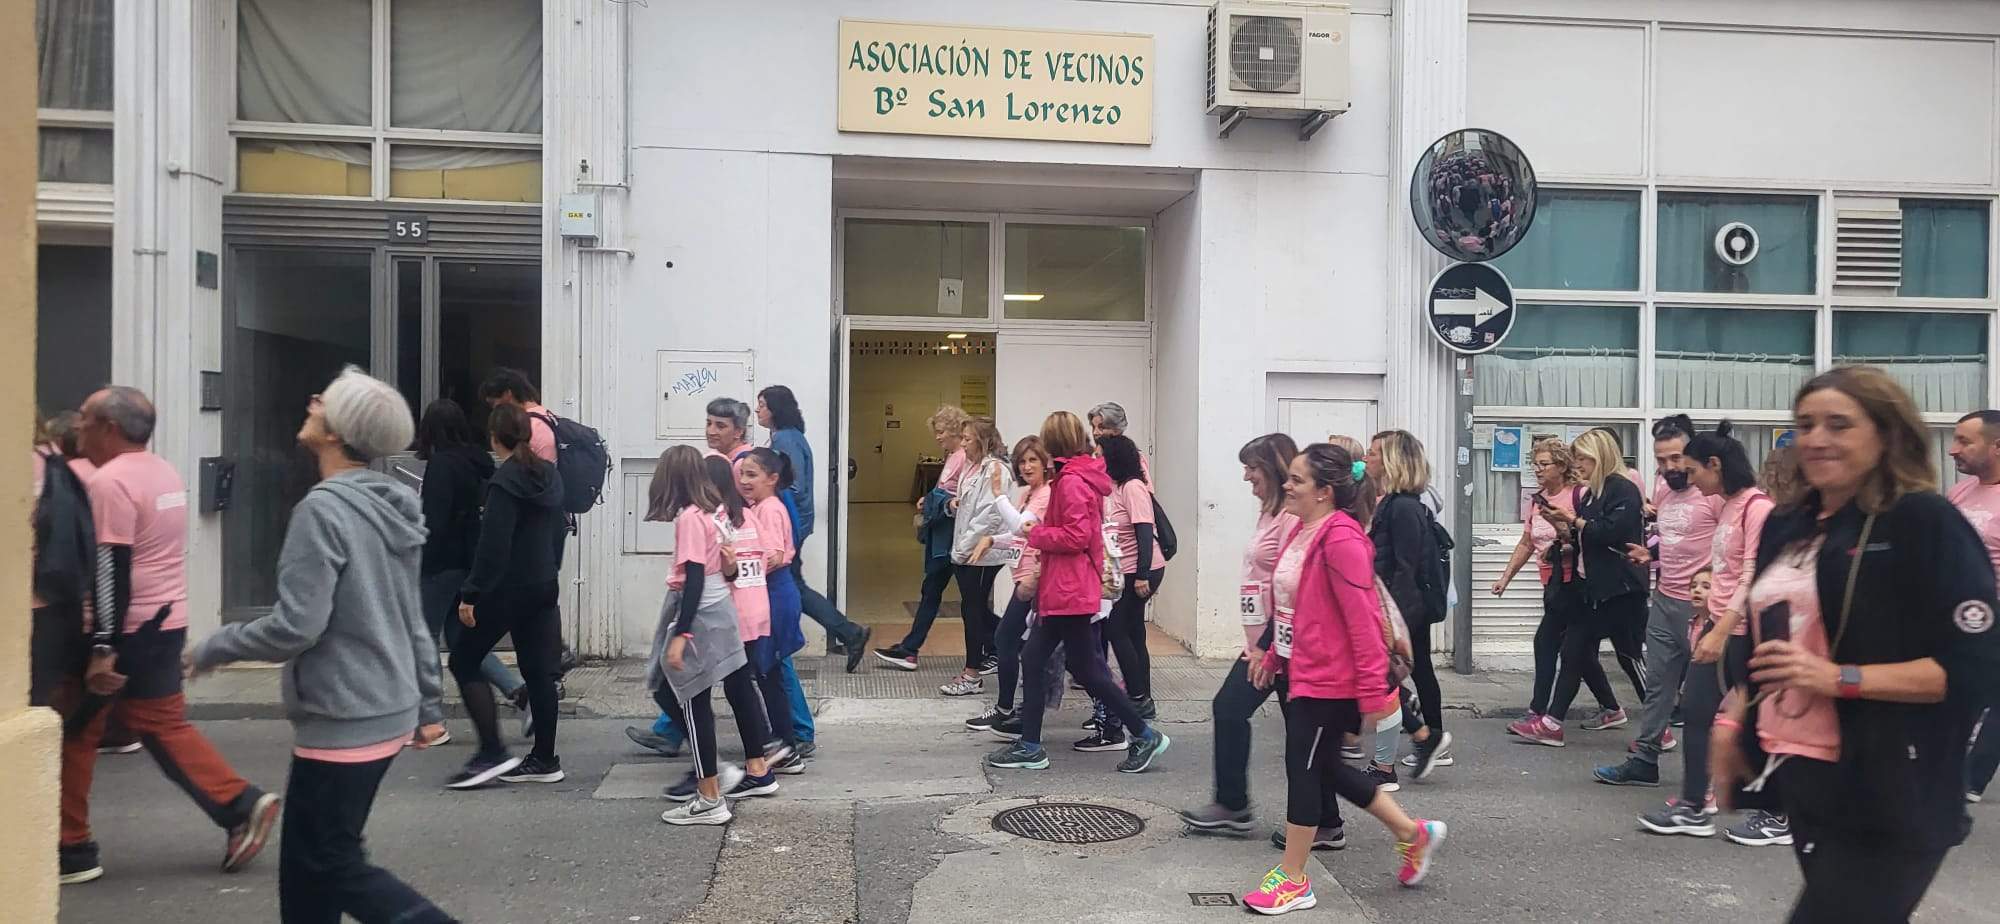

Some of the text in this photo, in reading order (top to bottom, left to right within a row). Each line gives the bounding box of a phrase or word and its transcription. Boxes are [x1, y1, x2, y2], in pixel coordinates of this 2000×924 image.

[849, 38, 1144, 86] ASOCIACIÓN DE VECINOS
[928, 89, 986, 119] San
[1005, 92, 1122, 125] Lorenzo
